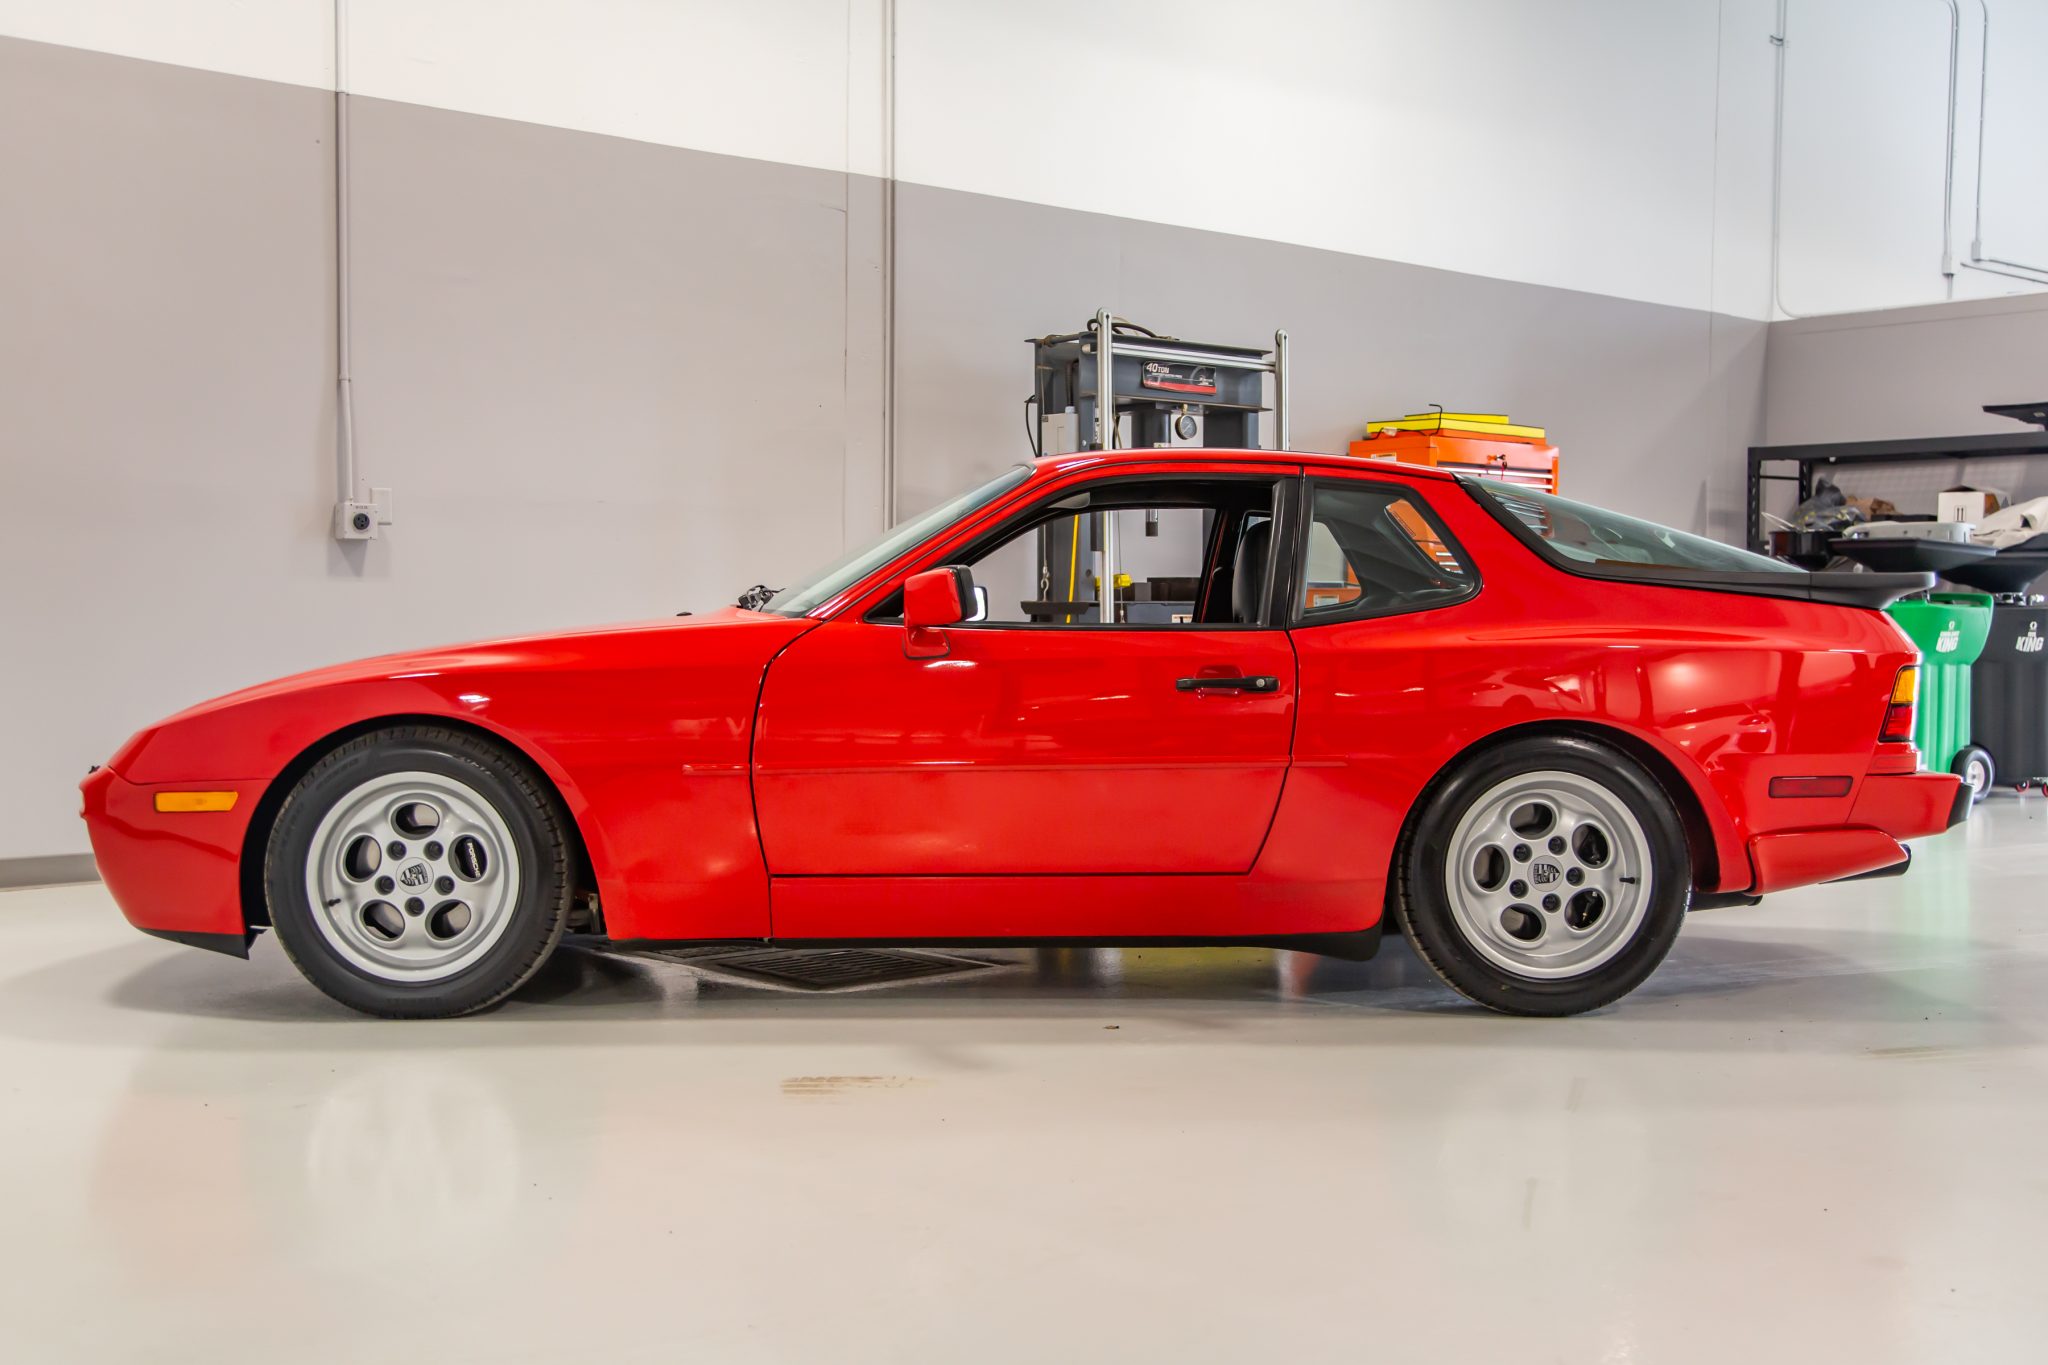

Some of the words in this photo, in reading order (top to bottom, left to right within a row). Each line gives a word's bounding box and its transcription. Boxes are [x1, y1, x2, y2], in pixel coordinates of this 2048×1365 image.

[1146, 362, 1158, 373] 40
[1158, 366, 1170, 374] TON
[1935, 636, 1959, 652] KING
[2015, 636, 2045, 652] KING
[466, 842, 481, 878] PORSCHE
